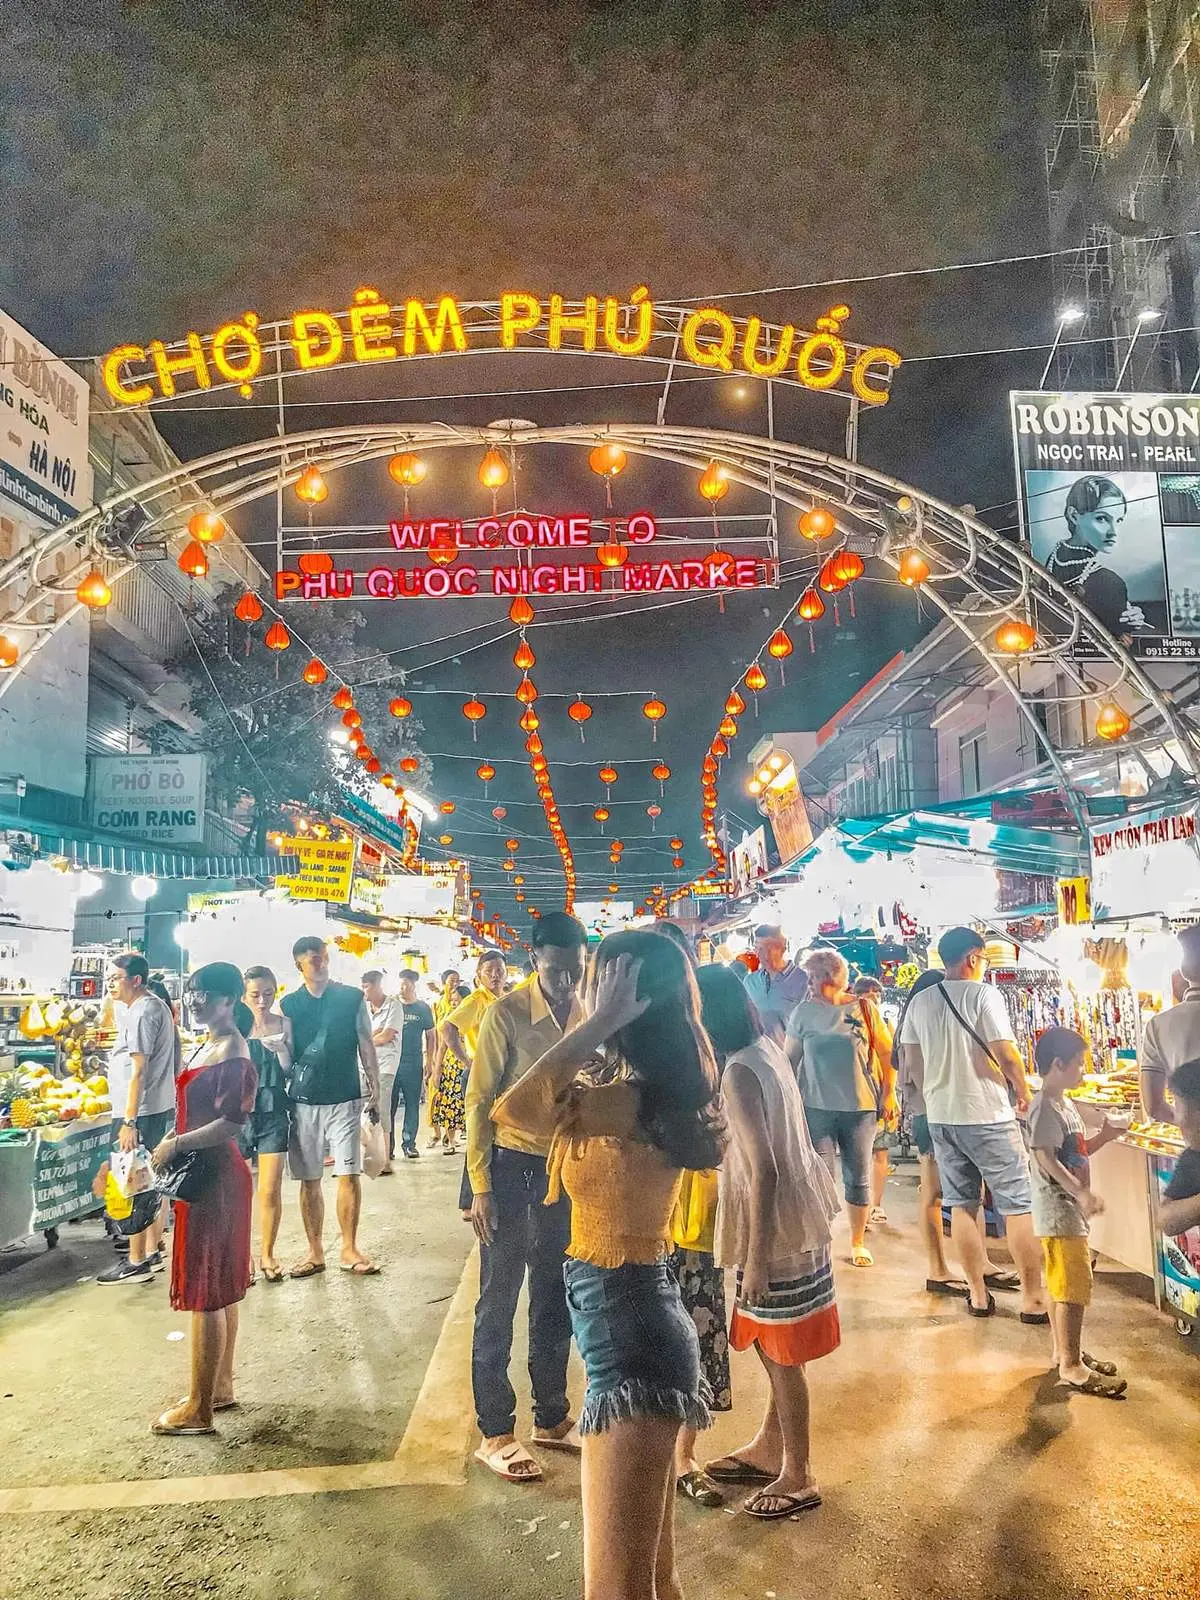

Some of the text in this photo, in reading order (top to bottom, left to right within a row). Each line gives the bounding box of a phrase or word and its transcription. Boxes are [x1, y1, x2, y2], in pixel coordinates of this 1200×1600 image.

[103, 283, 902, 406] CHỢ ĐÊM PHÚ QUỐC
[19, 397, 50, 436] HÓA
[1017, 404, 1200, 436] ROBINSON
[1037, 444, 1083, 463] NGỌC
[1086, 445, 1124, 461] TRAI
[1144, 445, 1196, 462] PEARL
[29, 439, 77, 497] HÀ NỘI
[389, 514, 655, 549] WELCOME TO
[275, 569, 353, 600] PHU
[367, 567, 479, 599] QUOC
[493, 564, 603, 595] NIGHT
[1145, 647, 1196, 656] 0915 22 58
[1162, 638, 1192, 647] Hotline
[111, 766, 185, 790] PHỞ BÒ
[98, 809, 196, 827] CƠM RANG
[151, 829, 175, 838] RICE
[295, 885, 314, 895] 0979
[315, 887, 329, 896] 185
[330, 888, 345, 898] 476
